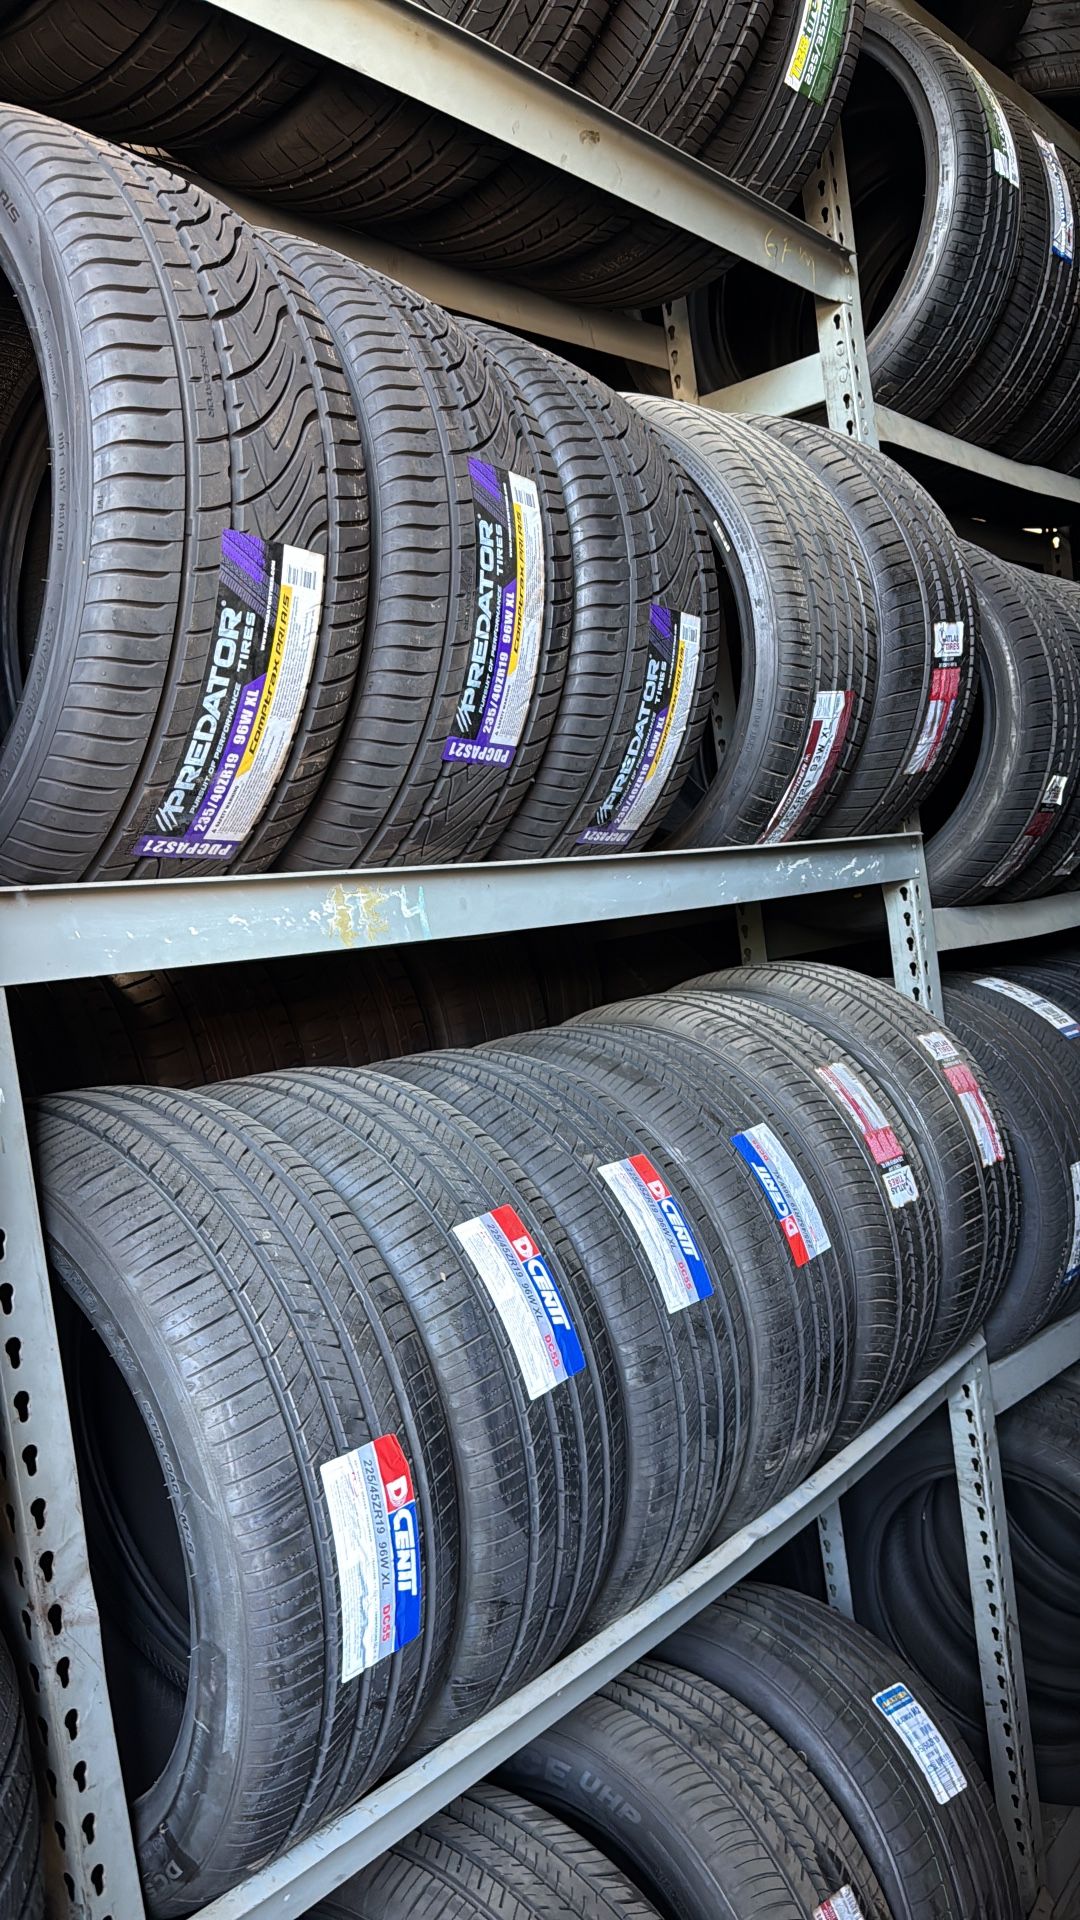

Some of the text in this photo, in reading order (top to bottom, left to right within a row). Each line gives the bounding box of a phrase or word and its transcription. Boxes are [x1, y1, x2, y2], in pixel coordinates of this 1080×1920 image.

[496, 523, 504, 577] TIRES
[236, 611, 257, 673] TIRES
[459, 519, 494, 713] PREDATOR
[479, 585, 502, 714] PURSUIT OF PERFORMANCE
[482, 592, 514, 734] 235/40ZR19 96W XL
[162, 606, 243, 814] PREDATOR
[654, 660, 667, 705] TIRES
[188, 682, 242, 815] PURSUIT OF PERFORMANCE
[602, 658, 660, 811] PREDATOR
[657, 715, 666, 730] XL
[193, 689, 260, 833] 235/40ZR19 96W XL
[143, 839, 233, 857] PDCPAS21
[887, 1174, 905, 1187] TIRES
[487, 1223, 544, 1322] 225/45ZR19 96W XL
[666, 1238, 677, 1250] XL
[544, 1334, 560, 1368] DC55
[143, 1400, 164, 1449] EXTRA
[363, 1459, 391, 1590] 225/45ZR19 96W XL
[382, 1604, 391, 1642] DC55
[579, 1769, 642, 1824] UHP
